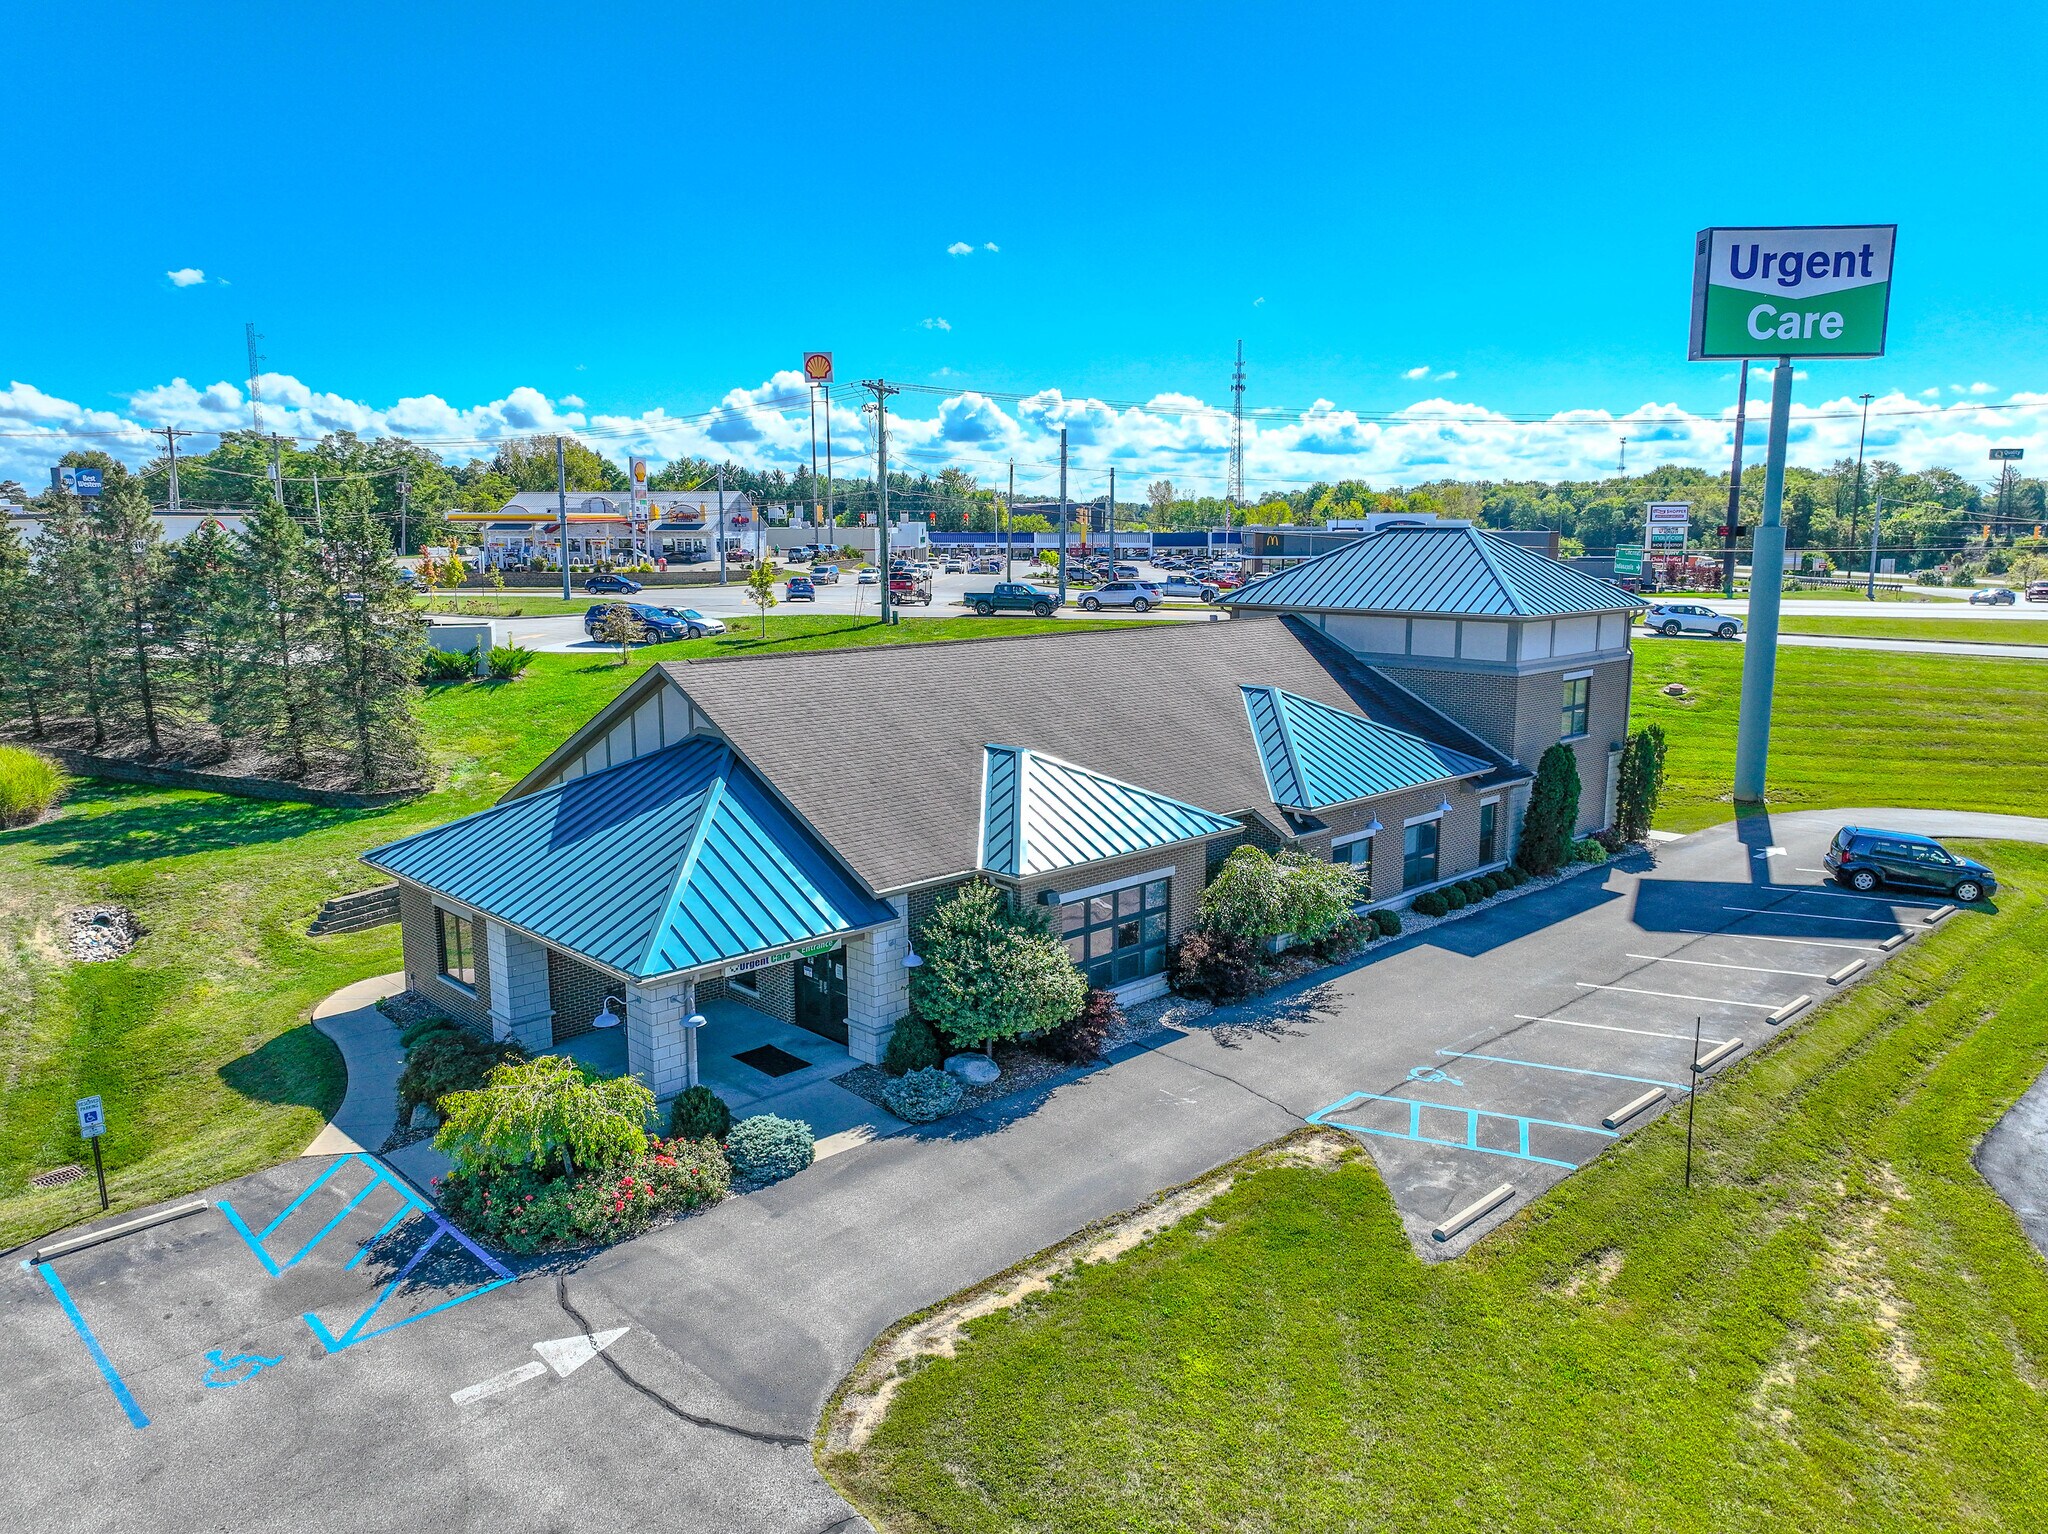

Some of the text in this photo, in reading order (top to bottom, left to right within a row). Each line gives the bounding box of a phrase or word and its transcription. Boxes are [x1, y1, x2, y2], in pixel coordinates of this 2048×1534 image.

[1730, 244, 1874, 287] Urgent
[1747, 304, 1844, 340] Care
[801, 940, 833, 953] Entrance
[740, 951, 791, 970] Urgent Care
